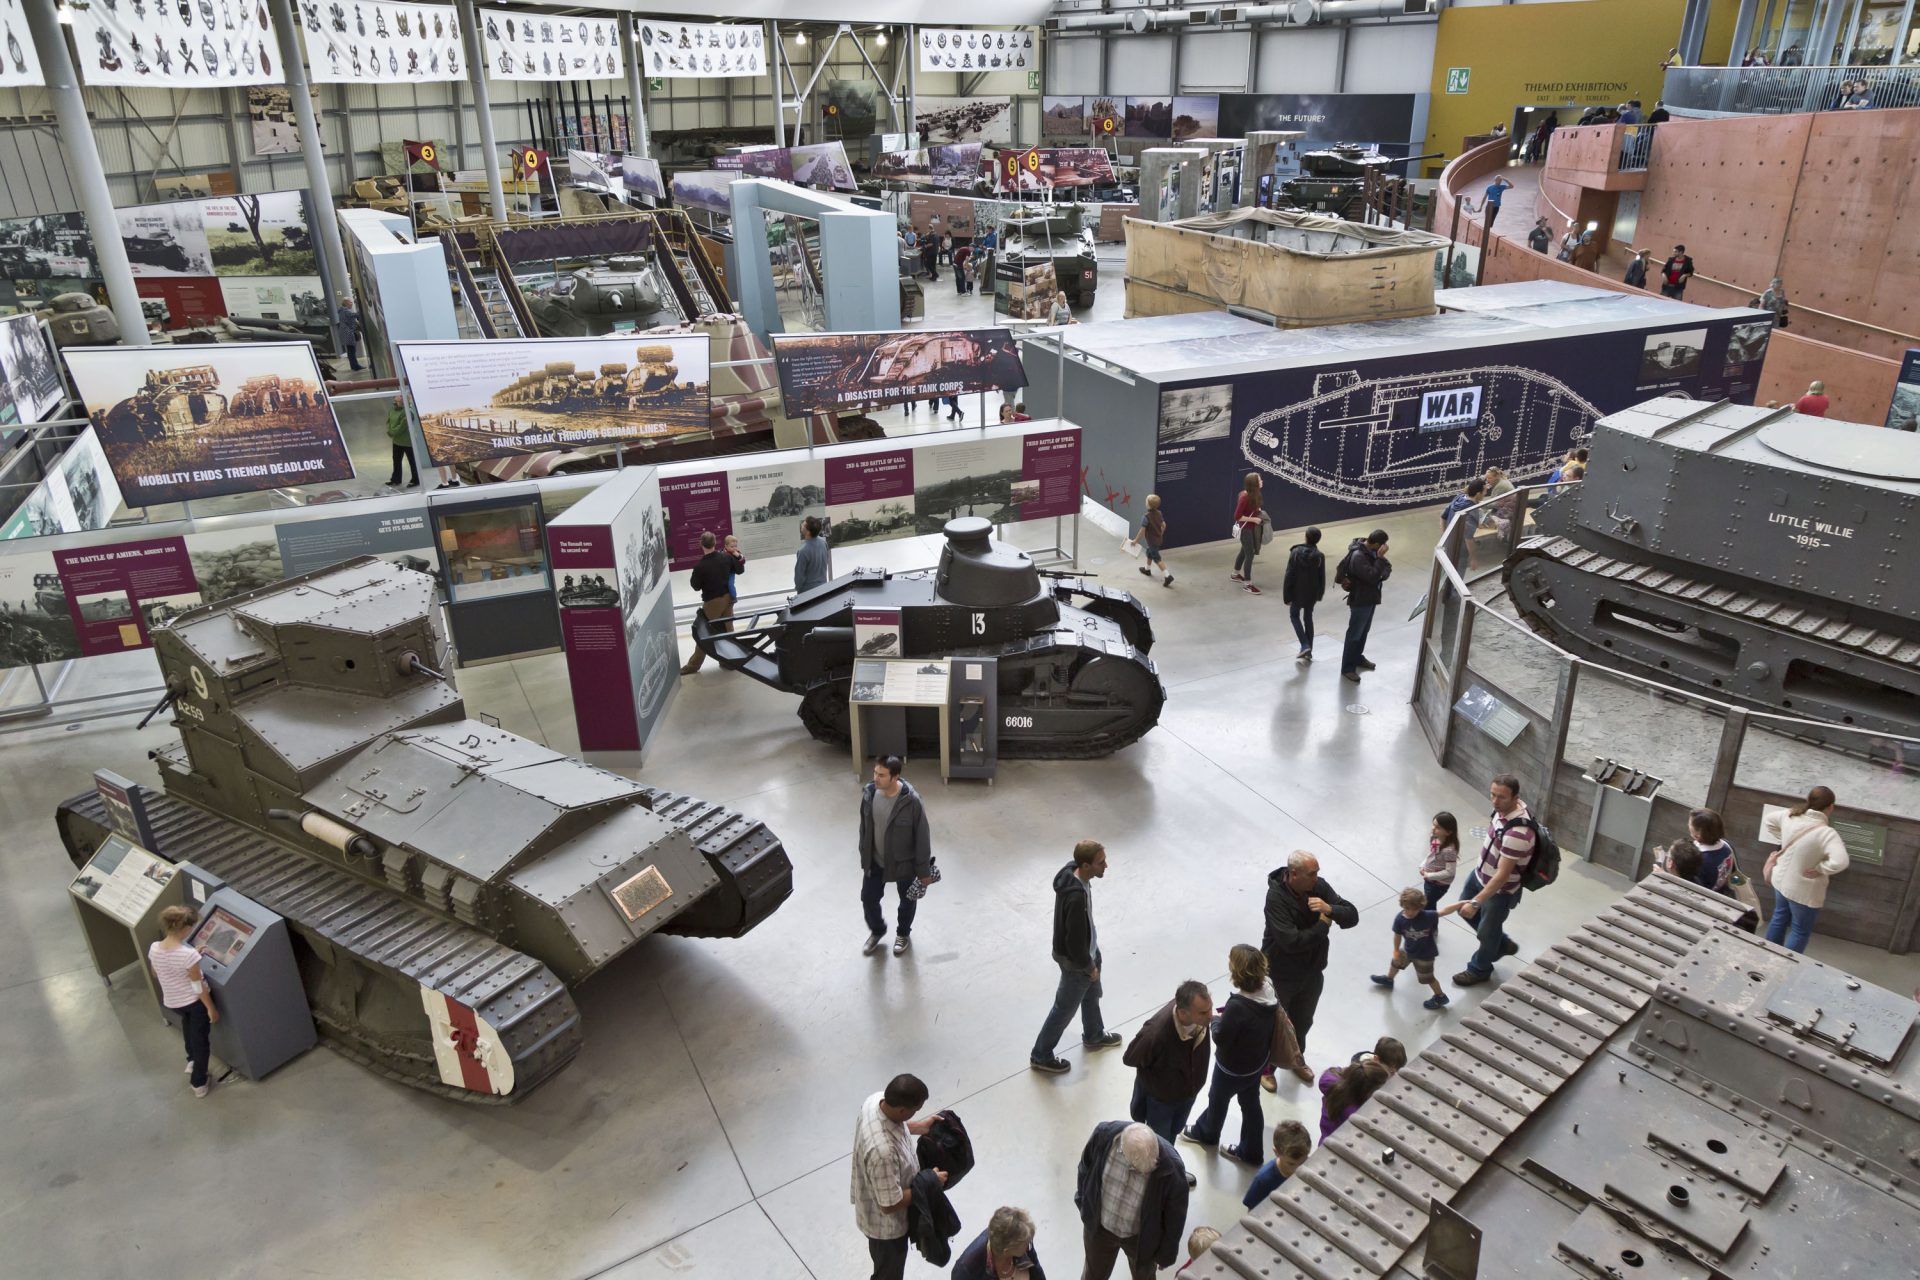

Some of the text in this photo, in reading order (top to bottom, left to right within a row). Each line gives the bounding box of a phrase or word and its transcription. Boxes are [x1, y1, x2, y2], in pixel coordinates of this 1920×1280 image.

[1525, 82, 1628, 92] THEMED EXHIBITIONS
[424, 149, 431, 158] 3
[528, 154, 535, 164] 4
[1390, 281, 1396, 290] 2
[837, 381, 964, 402] A DISASTER FOR THE TANK CORPS
[1427, 392, 1474, 419] WAR
[491, 423, 667, 448] TANKS BREAK THROUGH GERMAN LINES!
[138, 459, 325, 487] MOBILITY ENDS TRENCH DEADLOCK
[1768, 512, 1854, 538] LITTLE WILLIE
[116, 550, 143, 559] AMIENS,
[972, 613, 986, 635] 13
[190, 665, 208, 700] 9
[178, 699, 204, 721] A259
[1005, 716, 1032, 728] 66016
